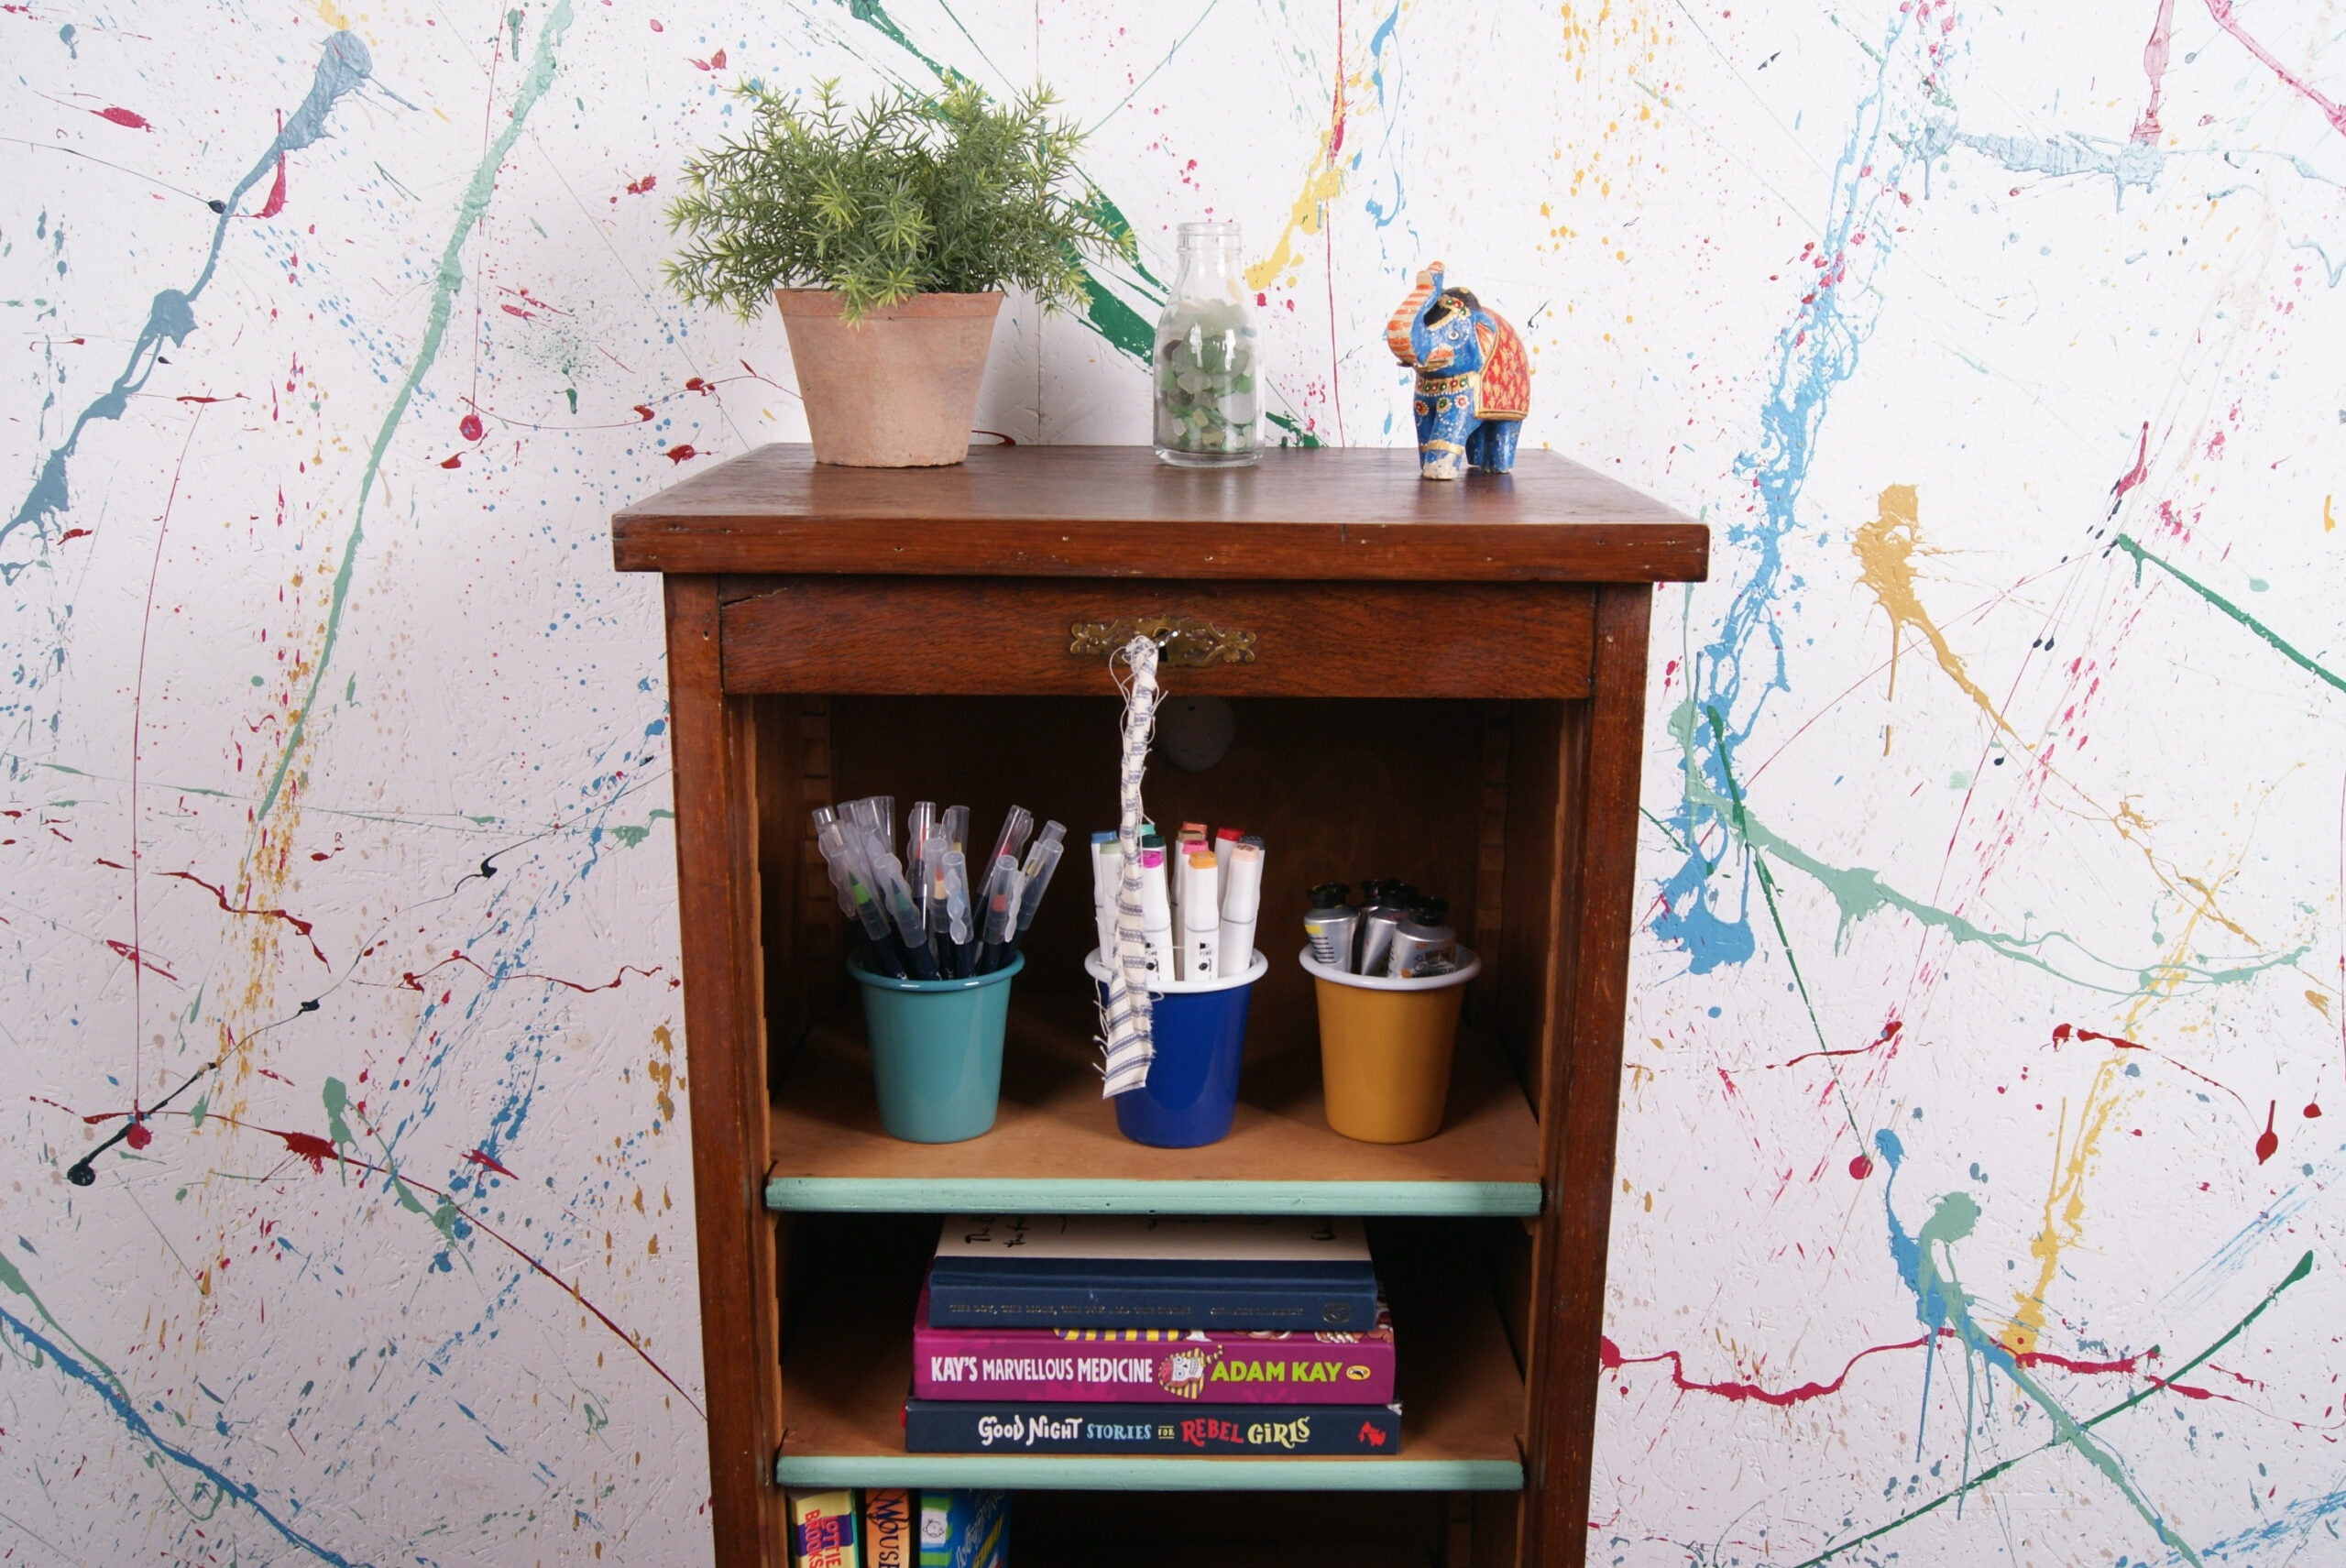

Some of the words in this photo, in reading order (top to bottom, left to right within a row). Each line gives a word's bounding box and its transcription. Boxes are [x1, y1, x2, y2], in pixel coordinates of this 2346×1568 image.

[931, 1356, 978, 1381] KAY'S
[982, 1358, 1074, 1381] MARVELLOUS
[1078, 1358, 1153, 1383] MEDICINE
[1211, 1361, 1285, 1382] ADAM
[1291, 1362, 1343, 1382] KAY
[1086, 1422, 1152, 1441] STORIES
[1180, 1418, 1244, 1447] REBEL
[821, 1515, 841, 1568] LOTTIE
